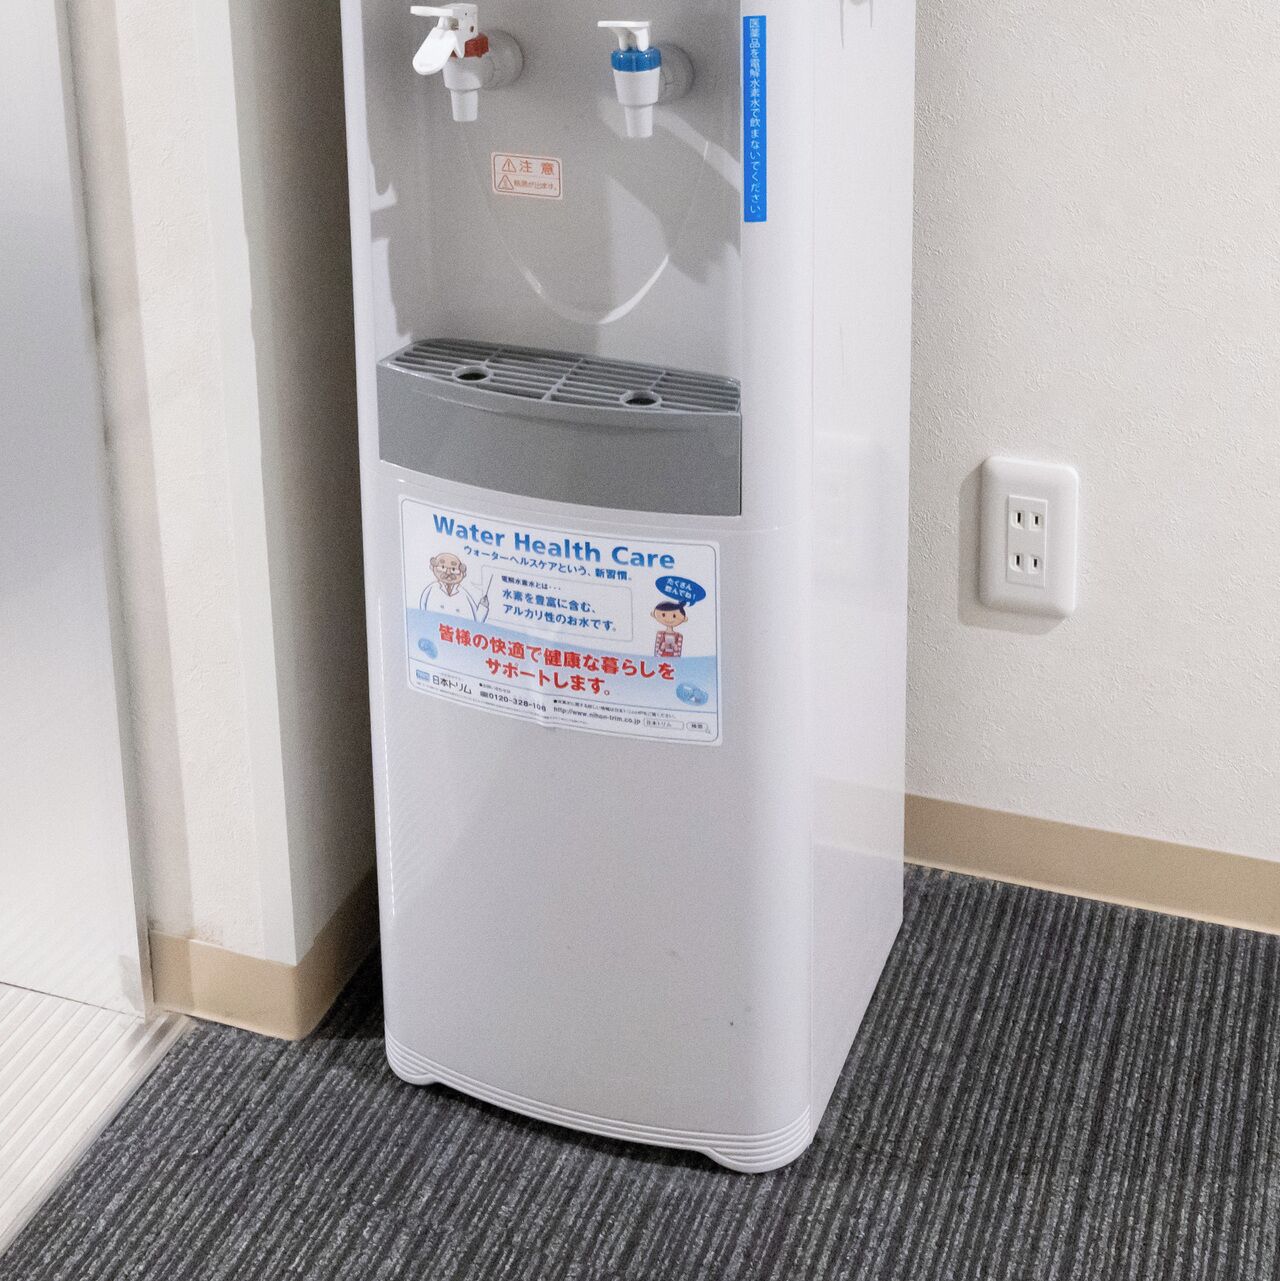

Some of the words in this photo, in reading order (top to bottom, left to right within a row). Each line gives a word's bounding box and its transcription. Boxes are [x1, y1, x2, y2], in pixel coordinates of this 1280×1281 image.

[433, 514, 505, 547] Water
[514, 532, 601, 563] Health
[611, 545, 675, 569] Care
[438, 623, 675, 681] 皆様の快適で健康な暮らしを
[432, 675, 472, 696] 日本トリム
[485, 657, 611, 697] サポートします。
